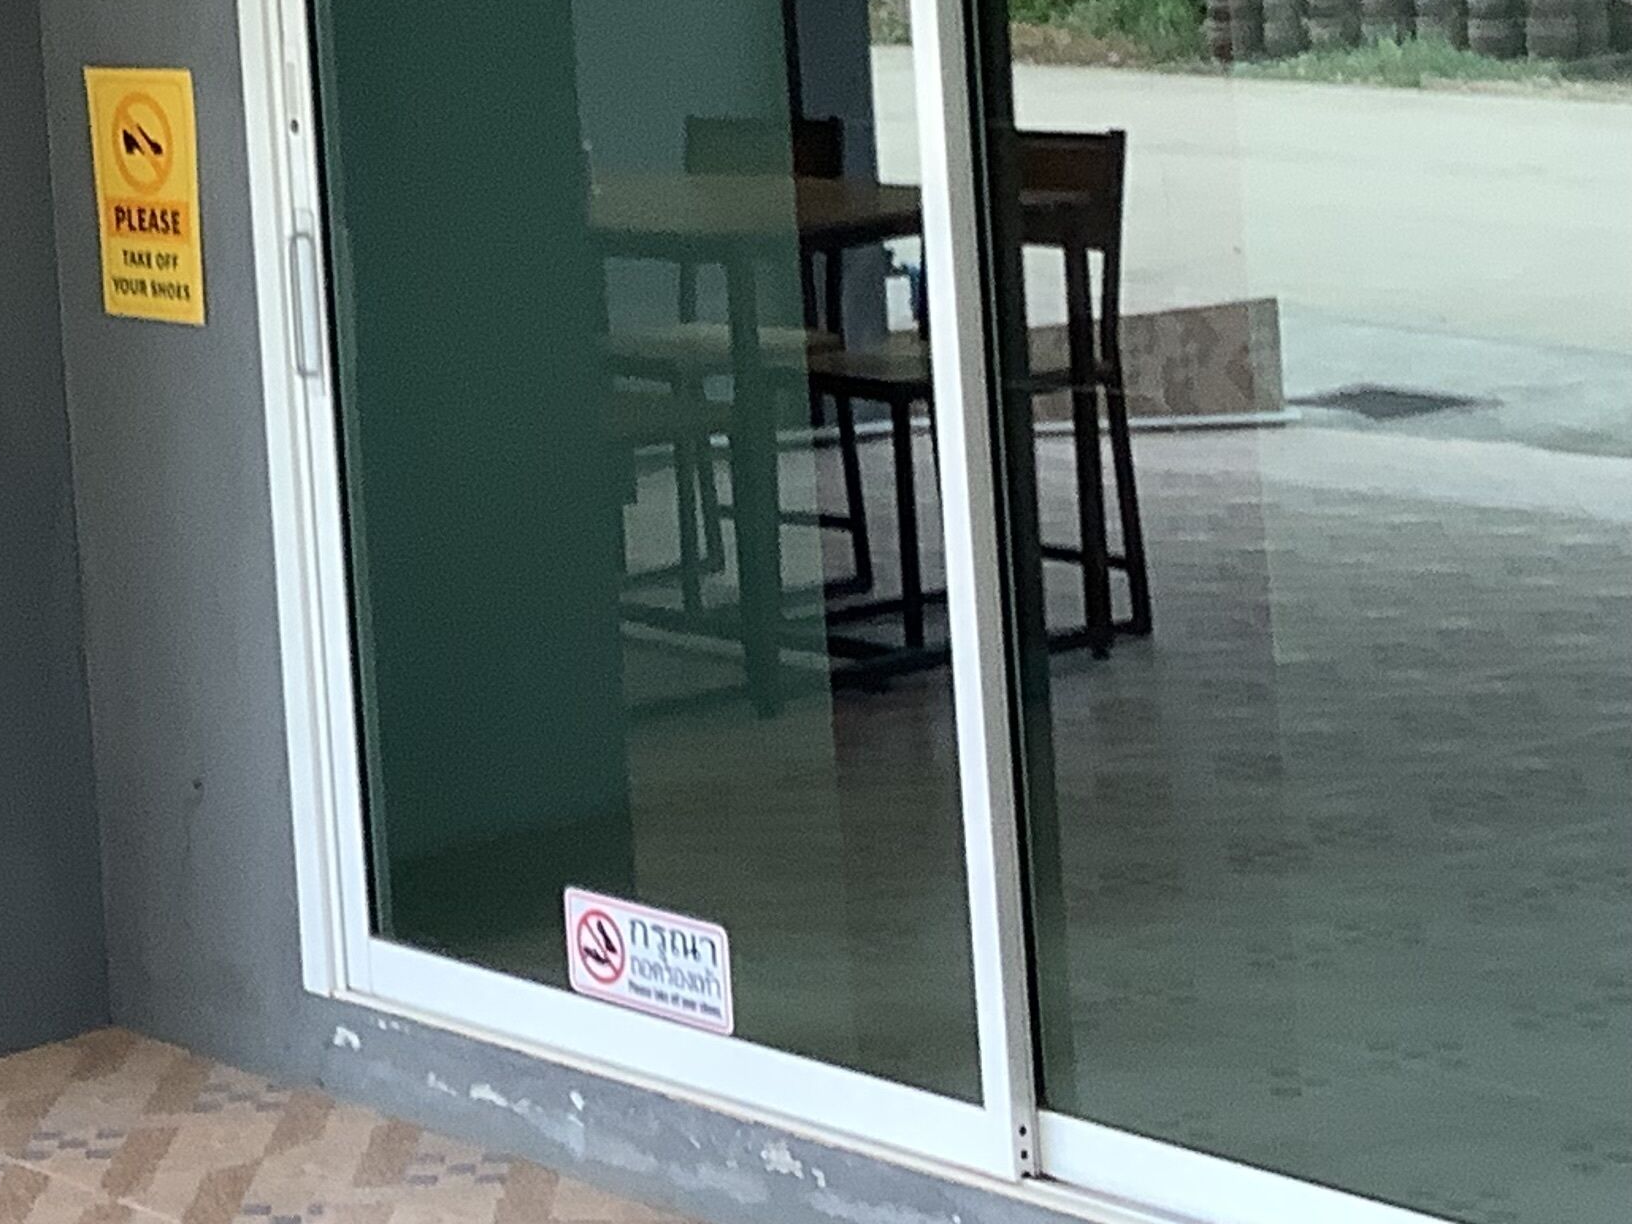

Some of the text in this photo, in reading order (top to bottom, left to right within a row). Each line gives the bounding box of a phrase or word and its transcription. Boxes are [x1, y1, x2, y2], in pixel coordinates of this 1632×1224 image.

[114, 205, 182, 234] PLEASE
[122, 249, 178, 271] TAKE OFF
[112, 277, 191, 302] YOUR SHOES
[630, 917, 717, 971] กรุณา
